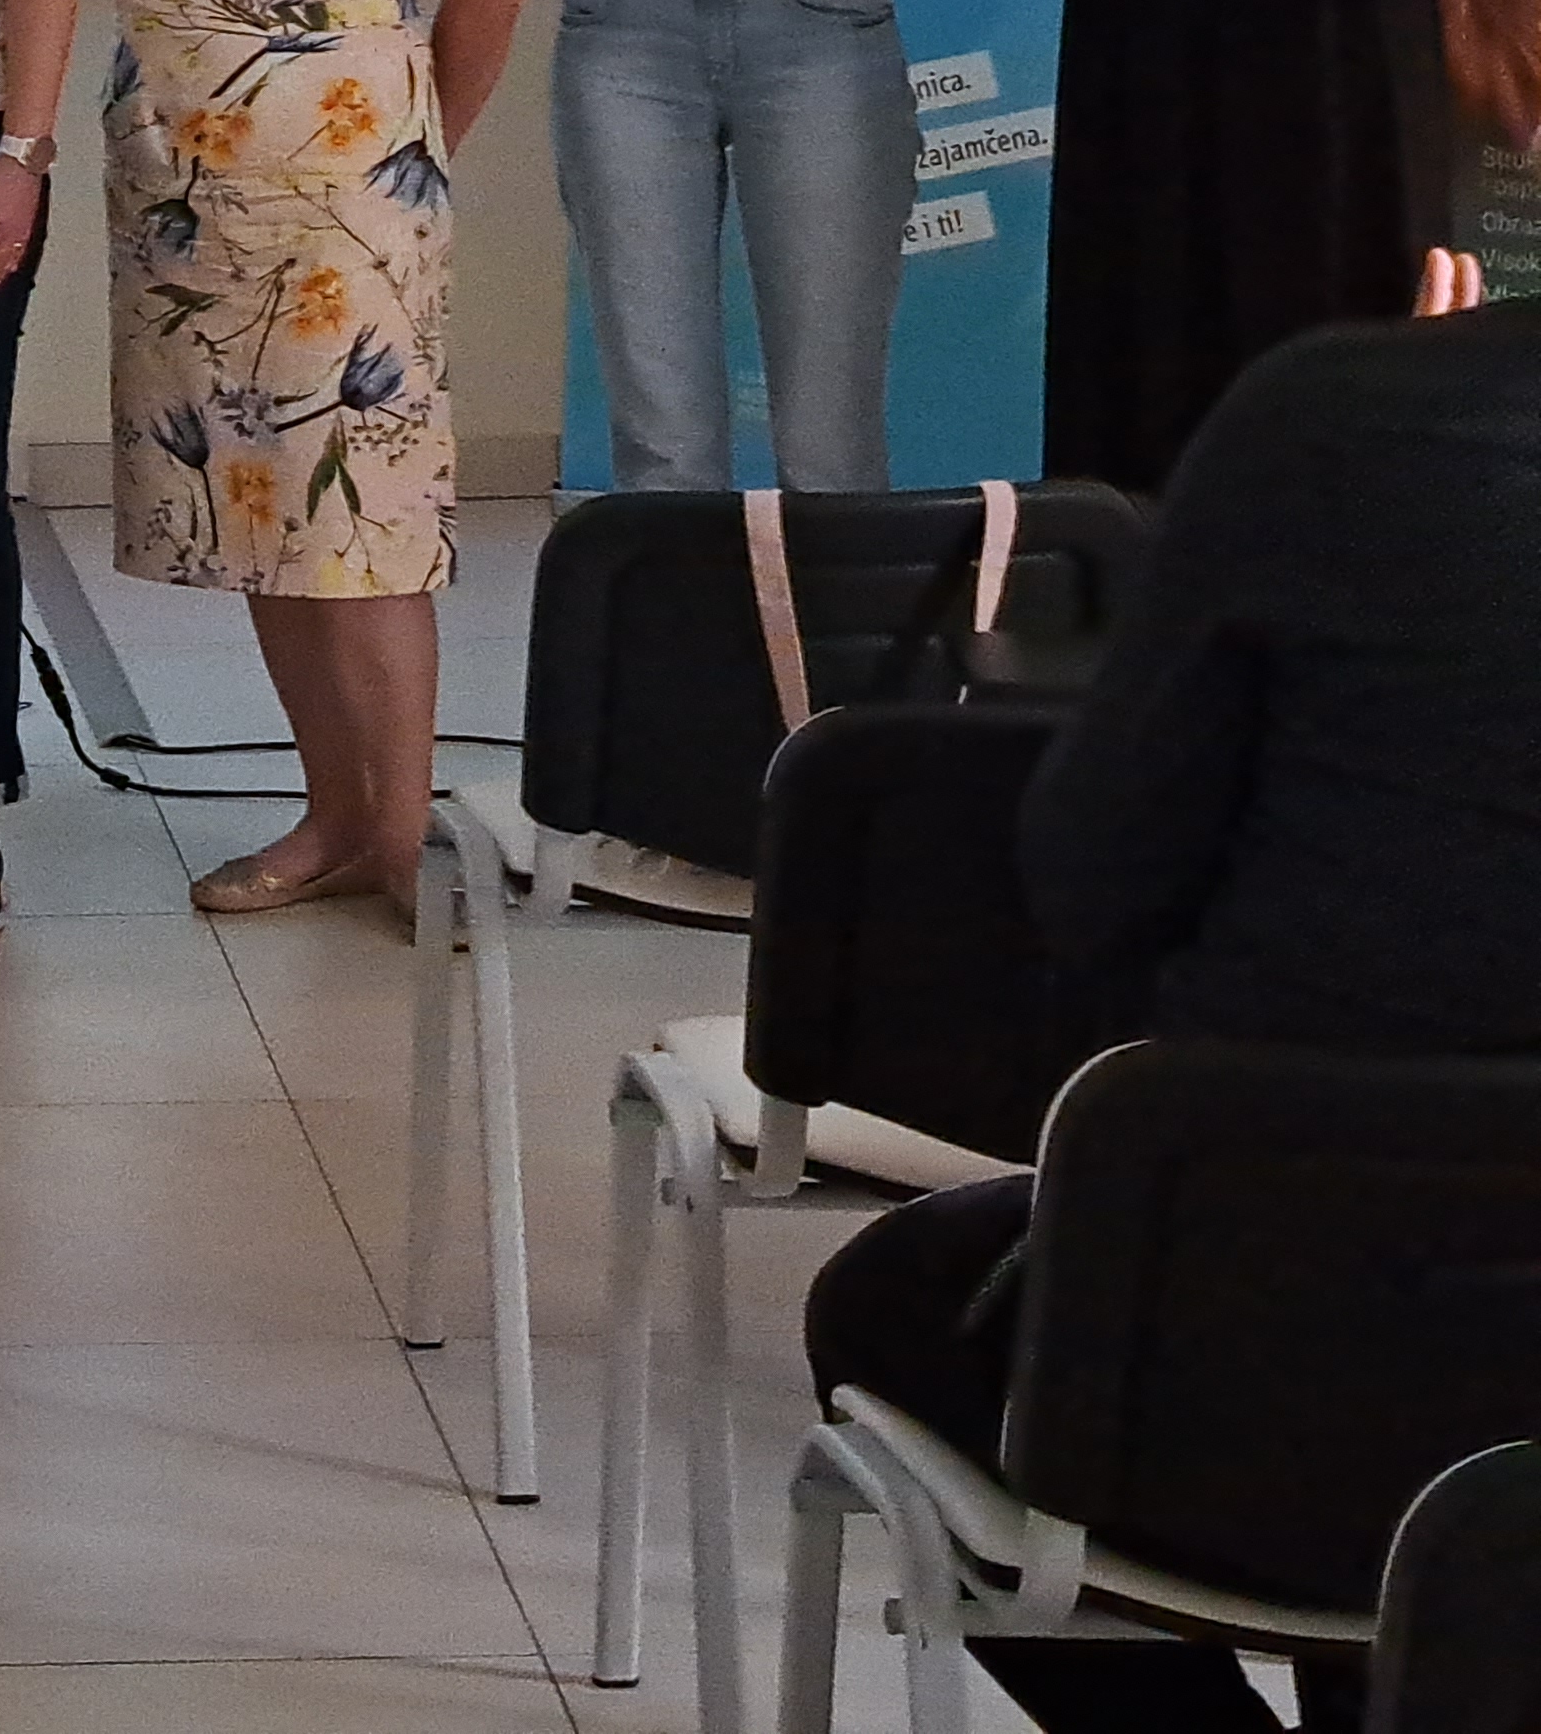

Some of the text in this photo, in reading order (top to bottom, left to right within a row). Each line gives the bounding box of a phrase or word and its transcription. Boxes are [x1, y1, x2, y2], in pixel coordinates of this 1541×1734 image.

[917, 71, 972, 101] nica.
[917, 127, 1049, 171] zajamčena.
[937, 208, 965, 237] ti!
